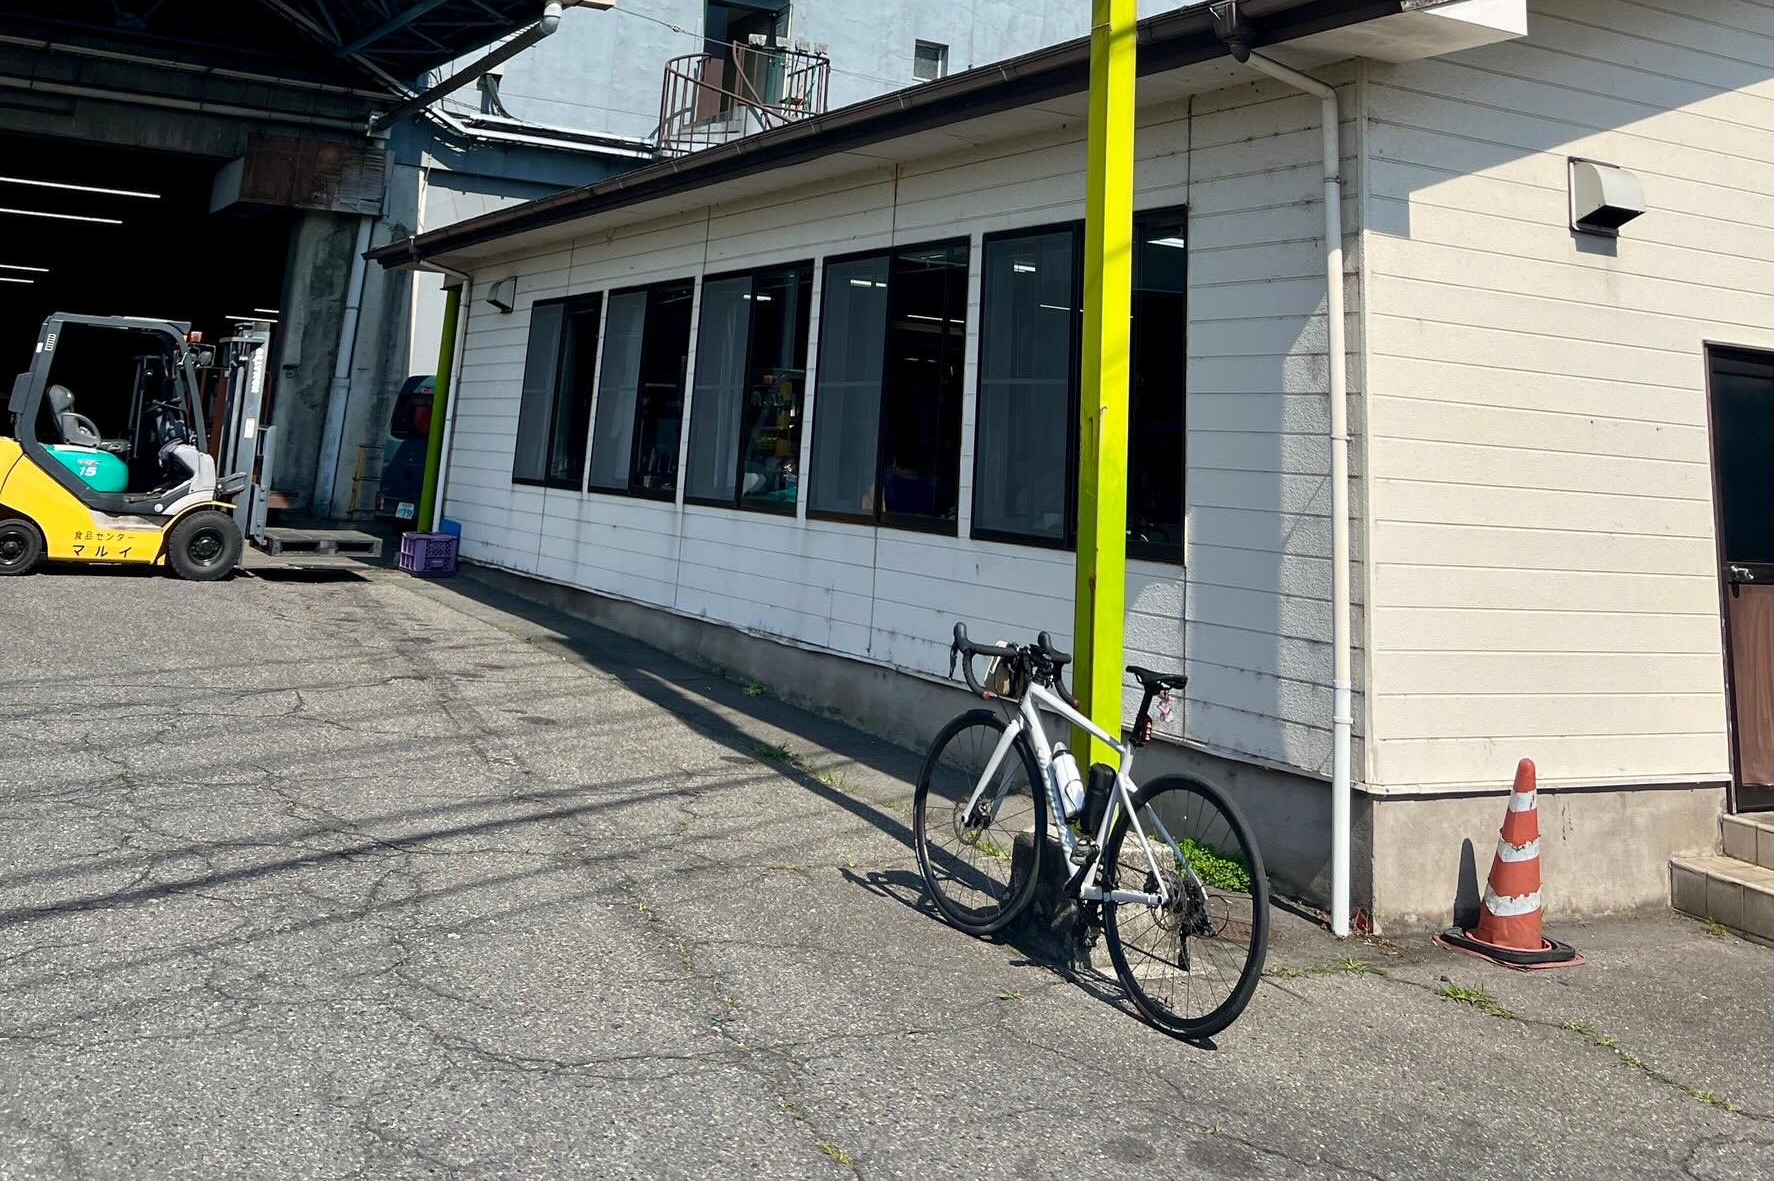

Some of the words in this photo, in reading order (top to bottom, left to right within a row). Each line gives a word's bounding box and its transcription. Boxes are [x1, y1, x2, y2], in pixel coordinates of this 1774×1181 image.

[74, 530, 135, 541] 食品センター
[72, 544, 132, 558] マルイ
